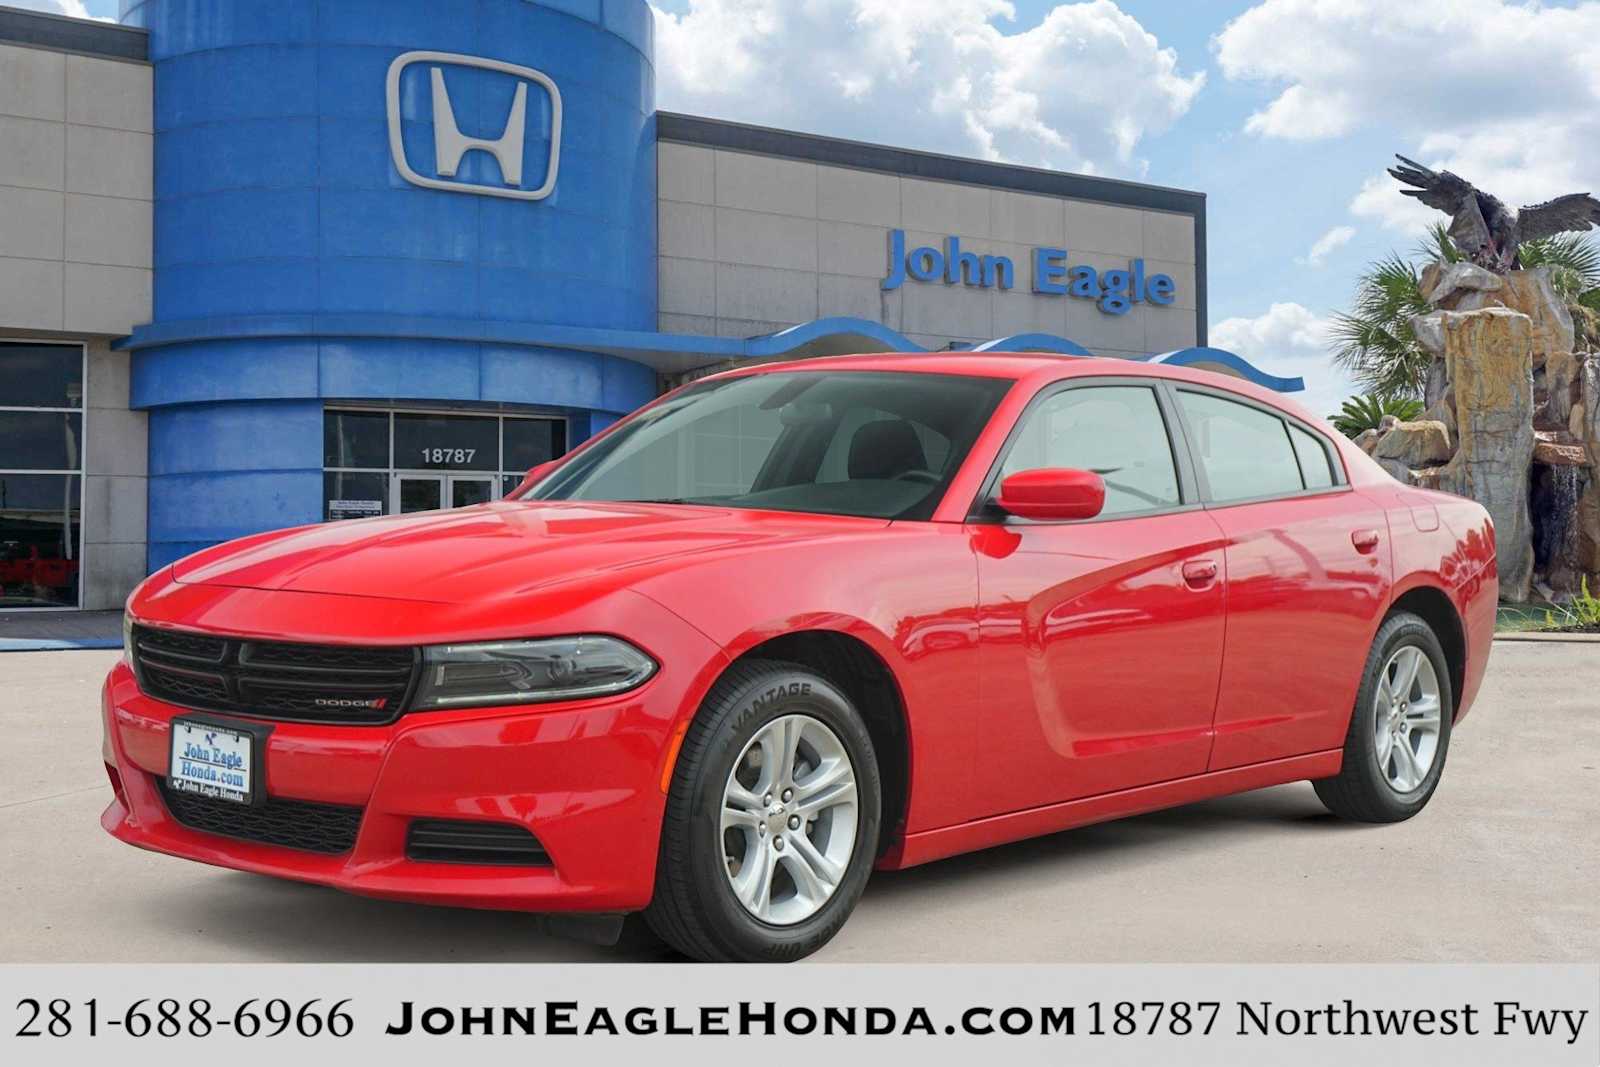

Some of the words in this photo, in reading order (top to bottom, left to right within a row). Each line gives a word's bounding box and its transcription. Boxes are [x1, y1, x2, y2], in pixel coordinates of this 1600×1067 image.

[880, 229, 1013, 291] John
[1031, 247, 1176, 315] Eagle
[421, 447, 476, 464] 18787
[731, 682, 812, 733] VANTAGE
[184, 741, 210, 762] John
[213, 748, 242, 769] Eagle
[181, 761, 244, 787] Honda.com
[181, 779, 199, 792] John
[200, 784, 220, 797] Eagle
[220, 788, 244, 801] Honda
